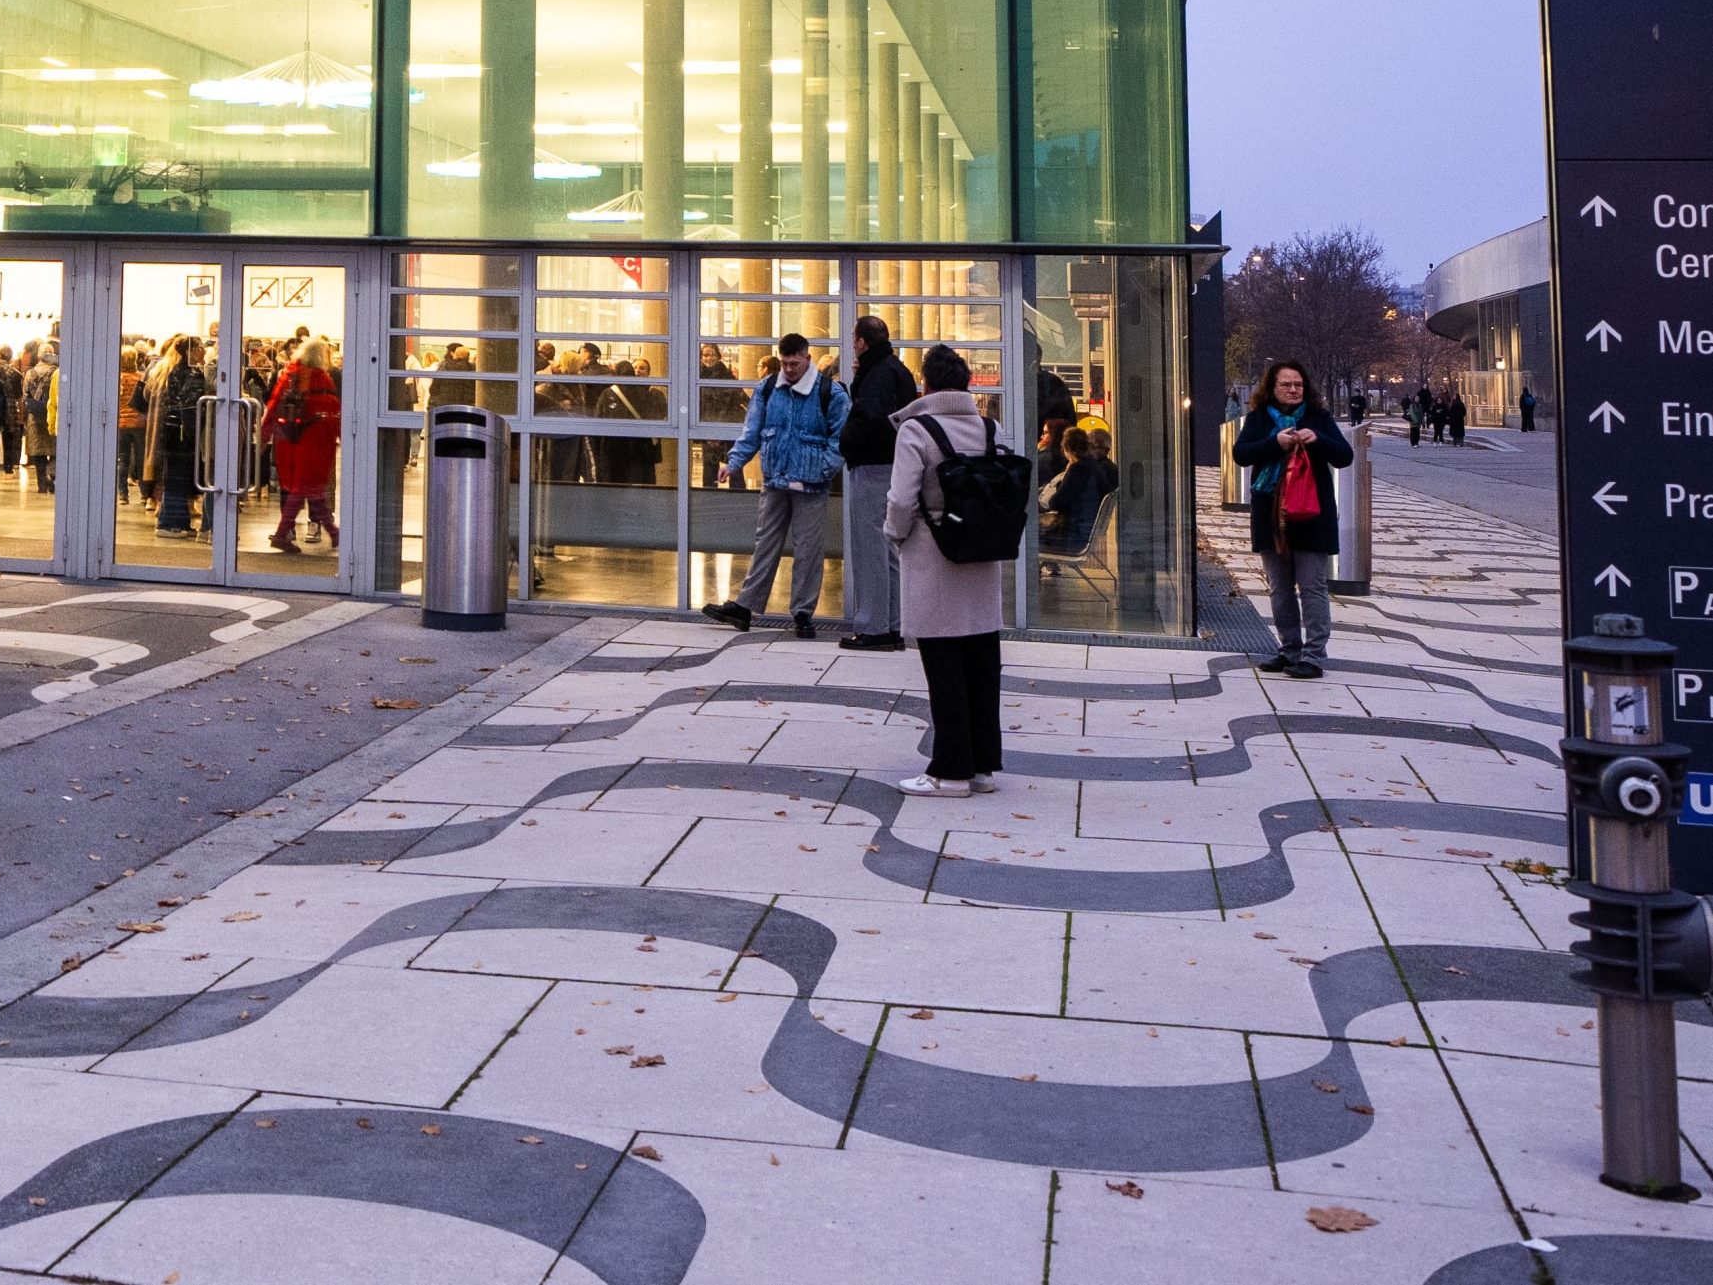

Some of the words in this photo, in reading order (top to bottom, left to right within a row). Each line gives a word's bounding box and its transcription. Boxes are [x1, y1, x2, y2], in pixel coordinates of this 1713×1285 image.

[1658, 320, 1713, 355] Me
[1661, 401, 1713, 436] Ein
[1673, 571, 1699, 604] P
[1677, 673, 1703, 707] P
